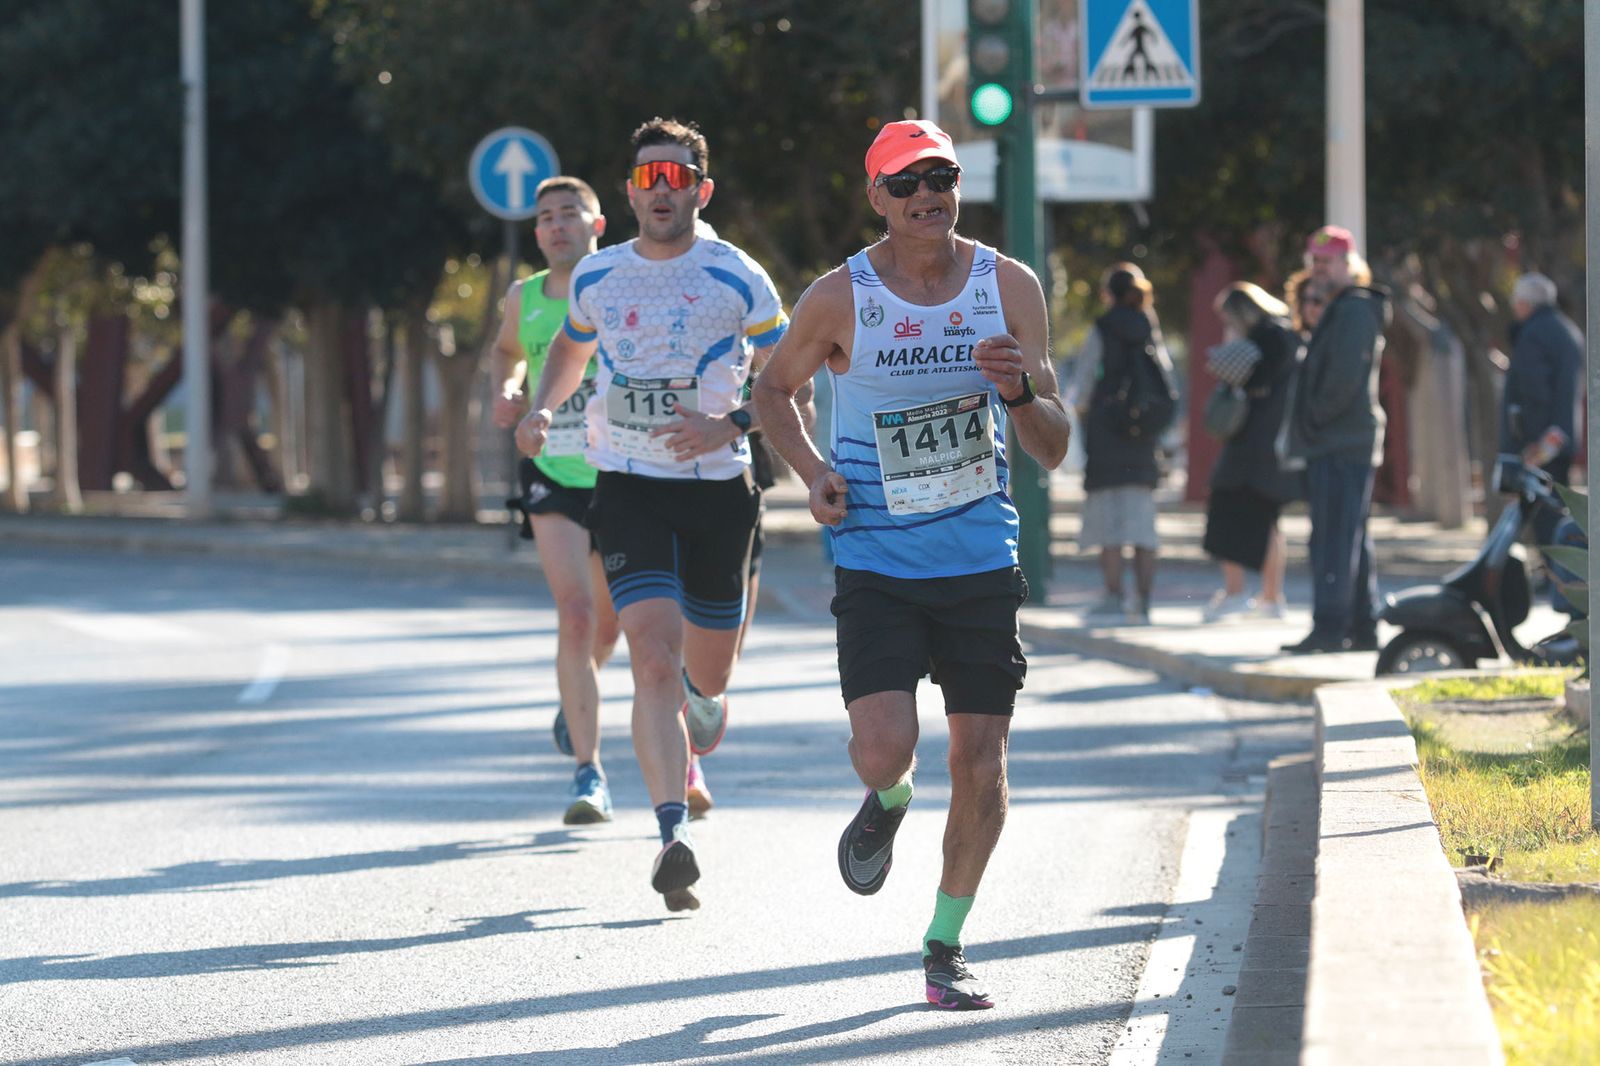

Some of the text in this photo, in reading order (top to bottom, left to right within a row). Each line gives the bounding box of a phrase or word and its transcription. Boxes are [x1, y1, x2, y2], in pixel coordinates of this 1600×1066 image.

[893, 316, 922, 338] als
[944, 326, 976, 338] mayfo
[890, 365, 983, 377] CLUB DE ATLETISMO
[624, 391, 679, 416] 119
[931, 408, 948, 418] 2022
[891, 411, 984, 458] 1414
[920, 450, 963, 465] MALPICA
